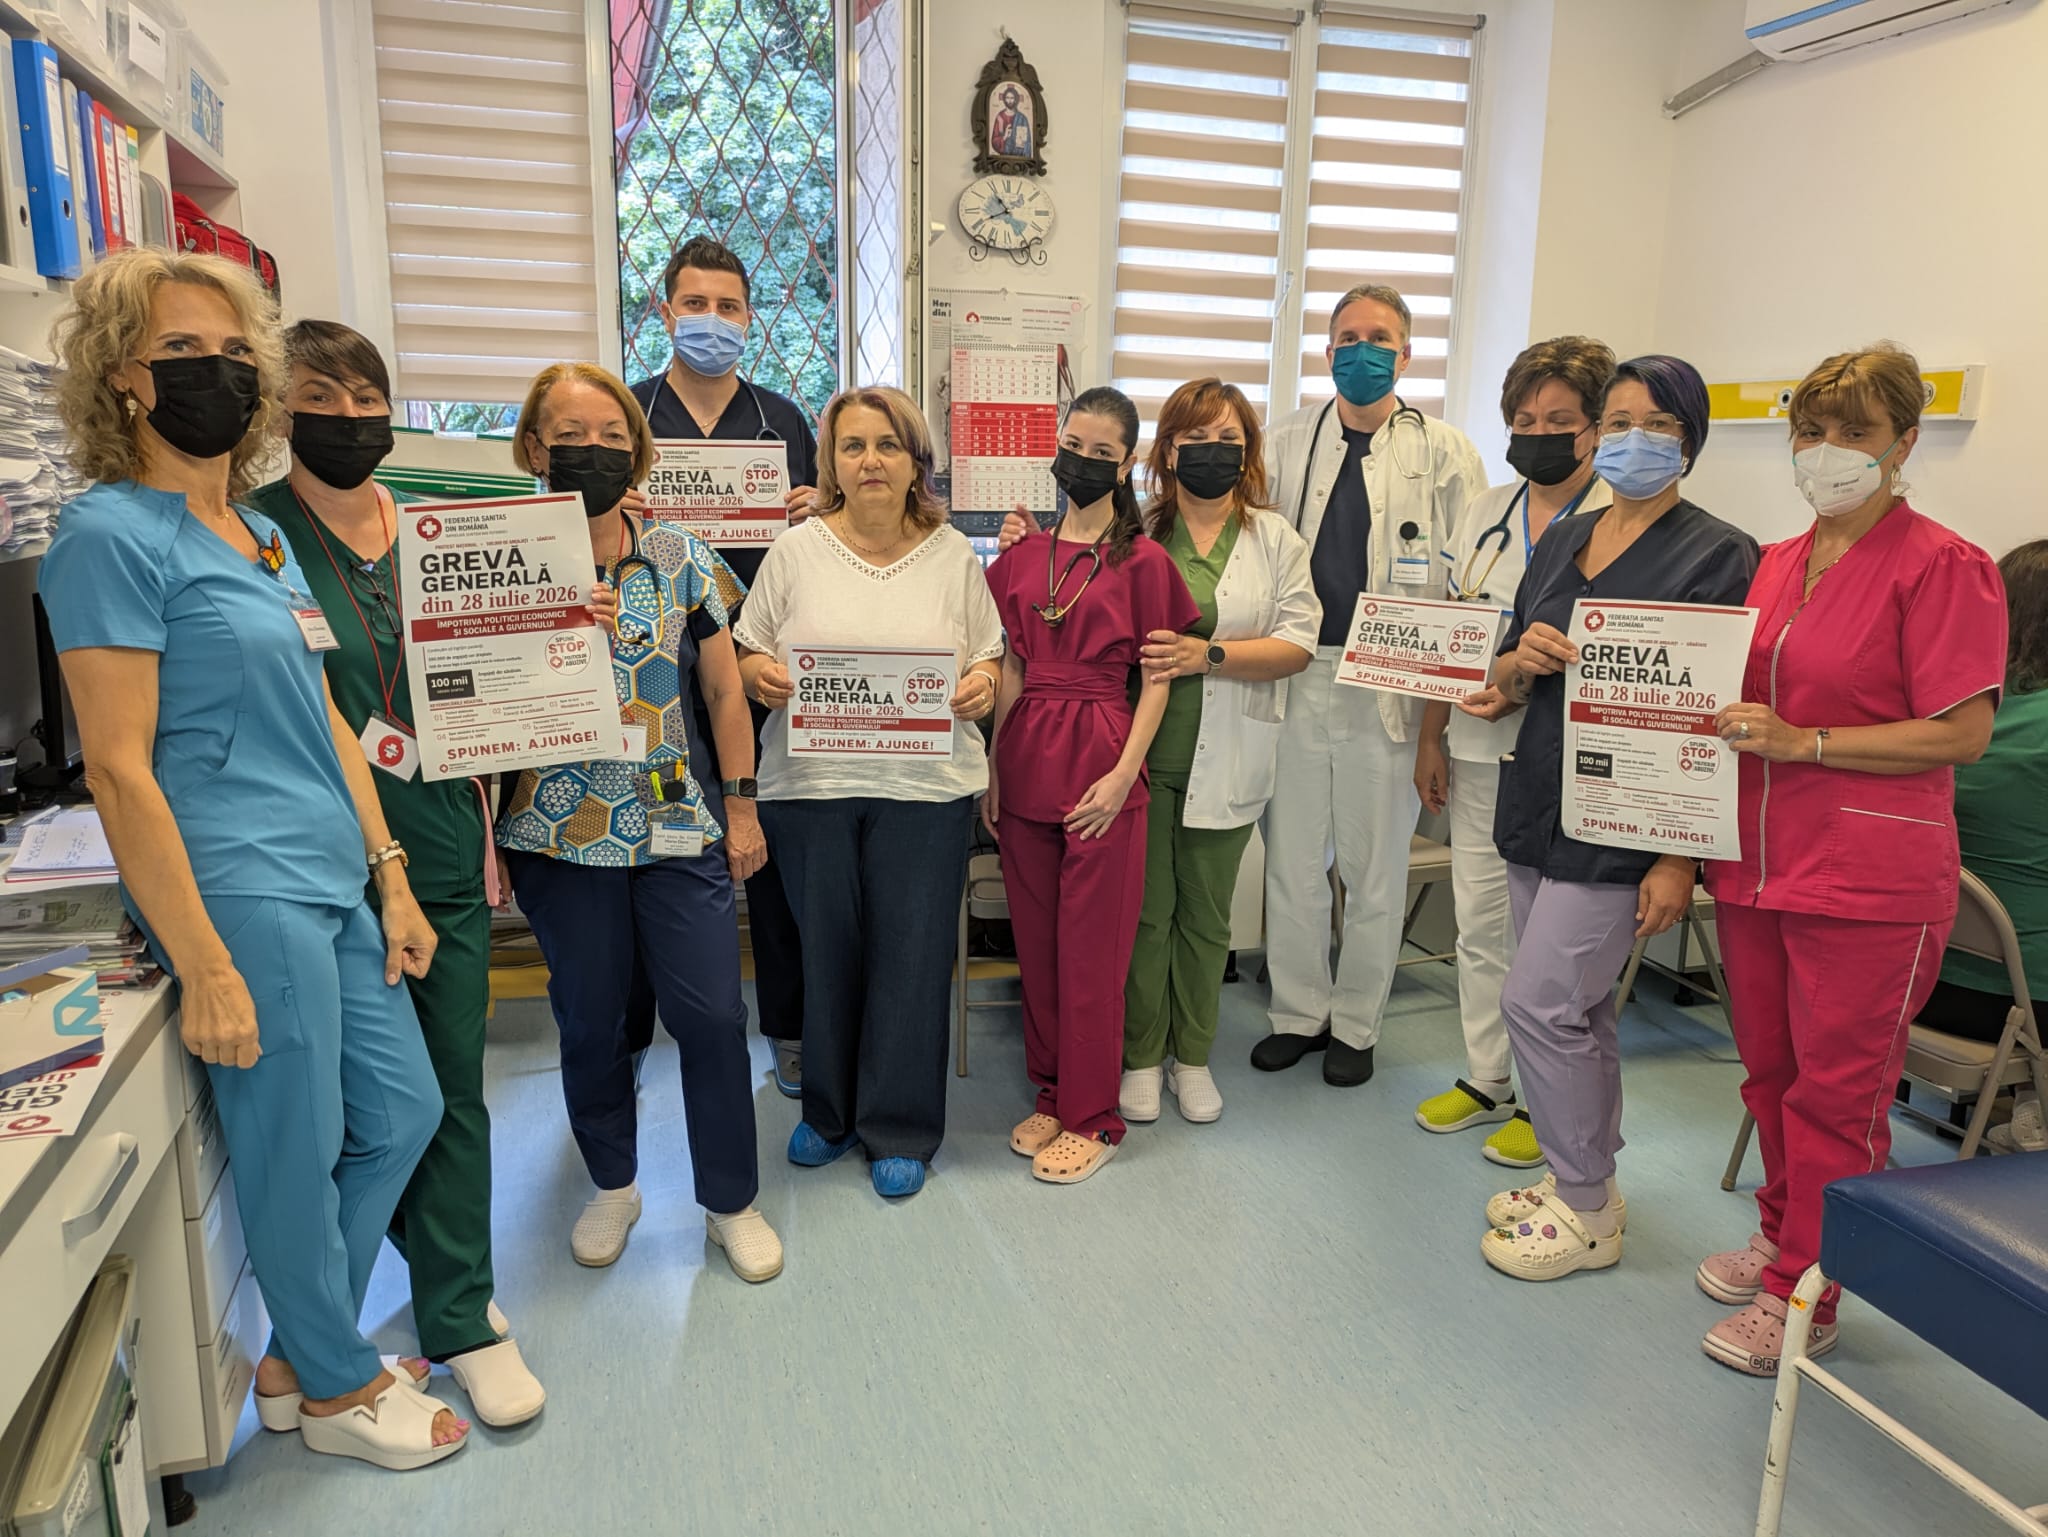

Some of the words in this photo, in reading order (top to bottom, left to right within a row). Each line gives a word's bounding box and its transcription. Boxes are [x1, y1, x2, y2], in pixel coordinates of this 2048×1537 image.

[648, 470, 712, 483] GREVĂ
[745, 470, 778, 480] STOP
[648, 482, 734, 495] GENERALĂ
[650, 496, 668, 506] din
[672, 497, 686, 506] 28
[690, 496, 715, 506] iulie
[719, 496, 743, 506] 2026
[444, 515, 480, 524] FEDERAȚIA
[458, 523, 488, 531] ROMÂNIA
[721, 530, 772, 538] AJUNGE!
[420, 545, 526, 574] GREVĂ
[421, 562, 552, 593] GENERALĂ
[422, 596, 454, 614] din
[460, 594, 483, 610] 28
[488, 590, 530, 608] iulie
[535, 586, 578, 604] 2026
[437, 618, 482, 629] ÎMPOTRIVA
[484, 614, 520, 624] POLITICII
[522, 610, 566, 622] ECONOMICE
[453, 628, 462, 637] ȘI
[463, 625, 496, 636] SOCIALE
[506, 621, 555, 632] GUVERNULUI
[1360, 621, 1420, 638] GREVĂ
[1452, 631, 1486, 642] STOP
[548, 641, 586, 654] STOP
[1358, 632, 1438, 652] GENERALĂ
[1356, 642, 1374, 652] din
[1377, 645, 1390, 654] 28
[1393, 648, 1418, 659] iulie
[1422, 652, 1446, 663] 2026
[1582, 644, 1670, 667] GREVĂ
[430, 678, 450, 688] 100
[452, 676, 468, 686] mii
[800, 674, 870, 692] GREVĂ
[1580, 664, 1692, 688] GENERALĂ
[908, 678, 944, 690] STOP
[1356, 671, 1410, 686] SPUNEM:
[1414, 682, 1468, 698] AJUNGE!
[800, 691, 894, 704] GENERALĂ
[1580, 682, 1604, 700] din
[1610, 685, 1628, 702] 28
[1634, 687, 1670, 706] iulie
[1676, 691, 1716, 710] 2026
[800, 704, 820, 714] din
[826, 704, 840, 714] 28
[844, 704, 872, 715] iulie
[876, 706, 904, 716] 2026
[1590, 706, 1626, 716] ÎMPOTRIVA
[1628, 710, 1660, 720] POLITICII
[1662, 714, 1704, 724] ECONOMICE
[1602, 716, 1608, 724] ȘI
[1610, 717, 1638, 726] SOCIALE
[1648, 721, 1692, 731] GUVERNULUI
[448, 742, 521, 760] SPUNEM:
[528, 730, 598, 750] AJUNGE!
[810, 738, 871, 749] SPUNEM:
[876, 740, 934, 750] AJUNGE!
[1681, 746, 1716, 760] STOP
[1579, 756, 1594, 765] 100
[1596, 758, 1608, 767] mii
[1582, 818, 1644, 835] SPUNEM:
[1649, 827, 1714, 844] AJUNGE!
